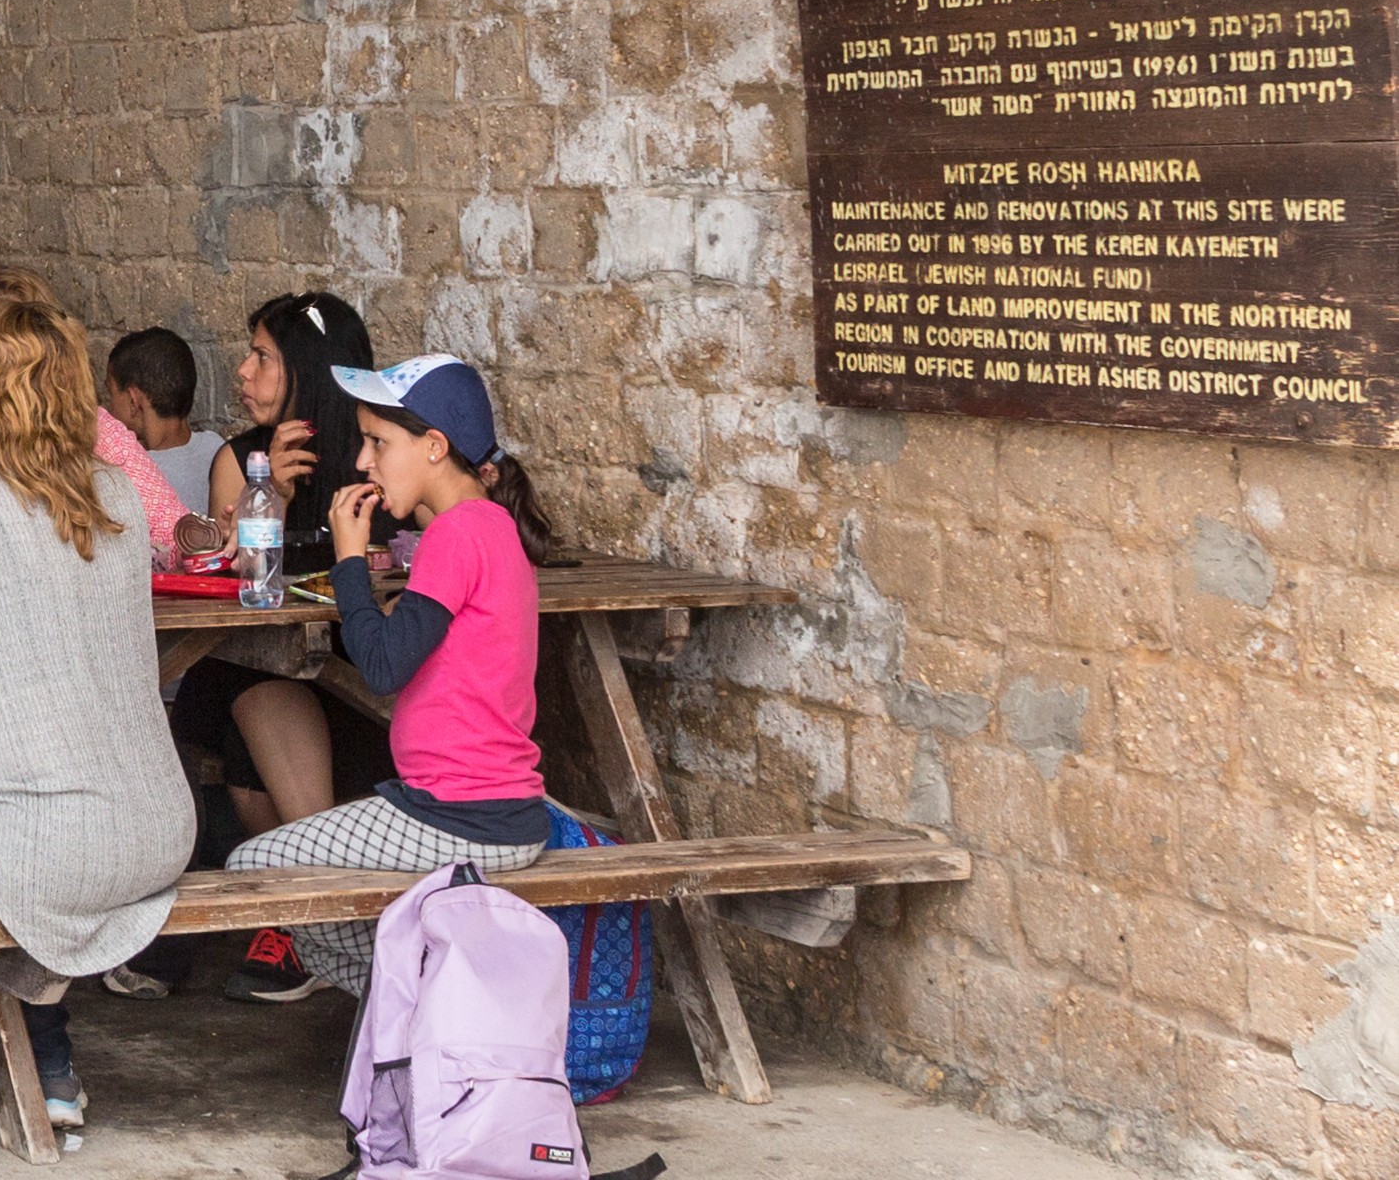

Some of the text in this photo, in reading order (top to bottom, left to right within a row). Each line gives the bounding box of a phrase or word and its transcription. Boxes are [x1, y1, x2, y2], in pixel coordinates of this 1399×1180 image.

[1110, 16, 1196, 42] לישראל
[1209, 13, 1281, 39] הקימת
[1295, 8, 1350, 37] הקרן
[842, 36, 891, 63] הצפון
[901, 35, 938, 55] חבל
[947, 32, 997, 57] קרקע
[1288, 46, 1354, 68] בשנת
[941, 65, 1001, 87] החברה
[1011, 63, 1036, 83] עם
[1047, 58, 1122, 85] בשיתוף
[1152, 85, 1247, 109] והמועצה
[1259, 78, 1352, 104] לתיירות
[944, 159, 1201, 184] MITZPE ROSH HANIKRA
[832, 198, 1346, 222] MAINTENANCE AND RENOVATIONS AT THIS SITE WERE
[834, 233, 1278, 257] CARRIED OUT IN 1996 BY THE KEREN KAYEMETH
[834, 263, 1151, 291] LEISRAEL (JEWISH NATIONAL FUND)
[835, 293, 1351, 330] AS PART OF LAND IMPROVEMENT IN THE NORTHERN
[835, 323, 1301, 364] REGION IN COOPERATION WITH THE GOVERNMENT
[836, 351, 1369, 404] TOURISM OFFICE AND MATEH ASHER DISTRICT COUNCIL
